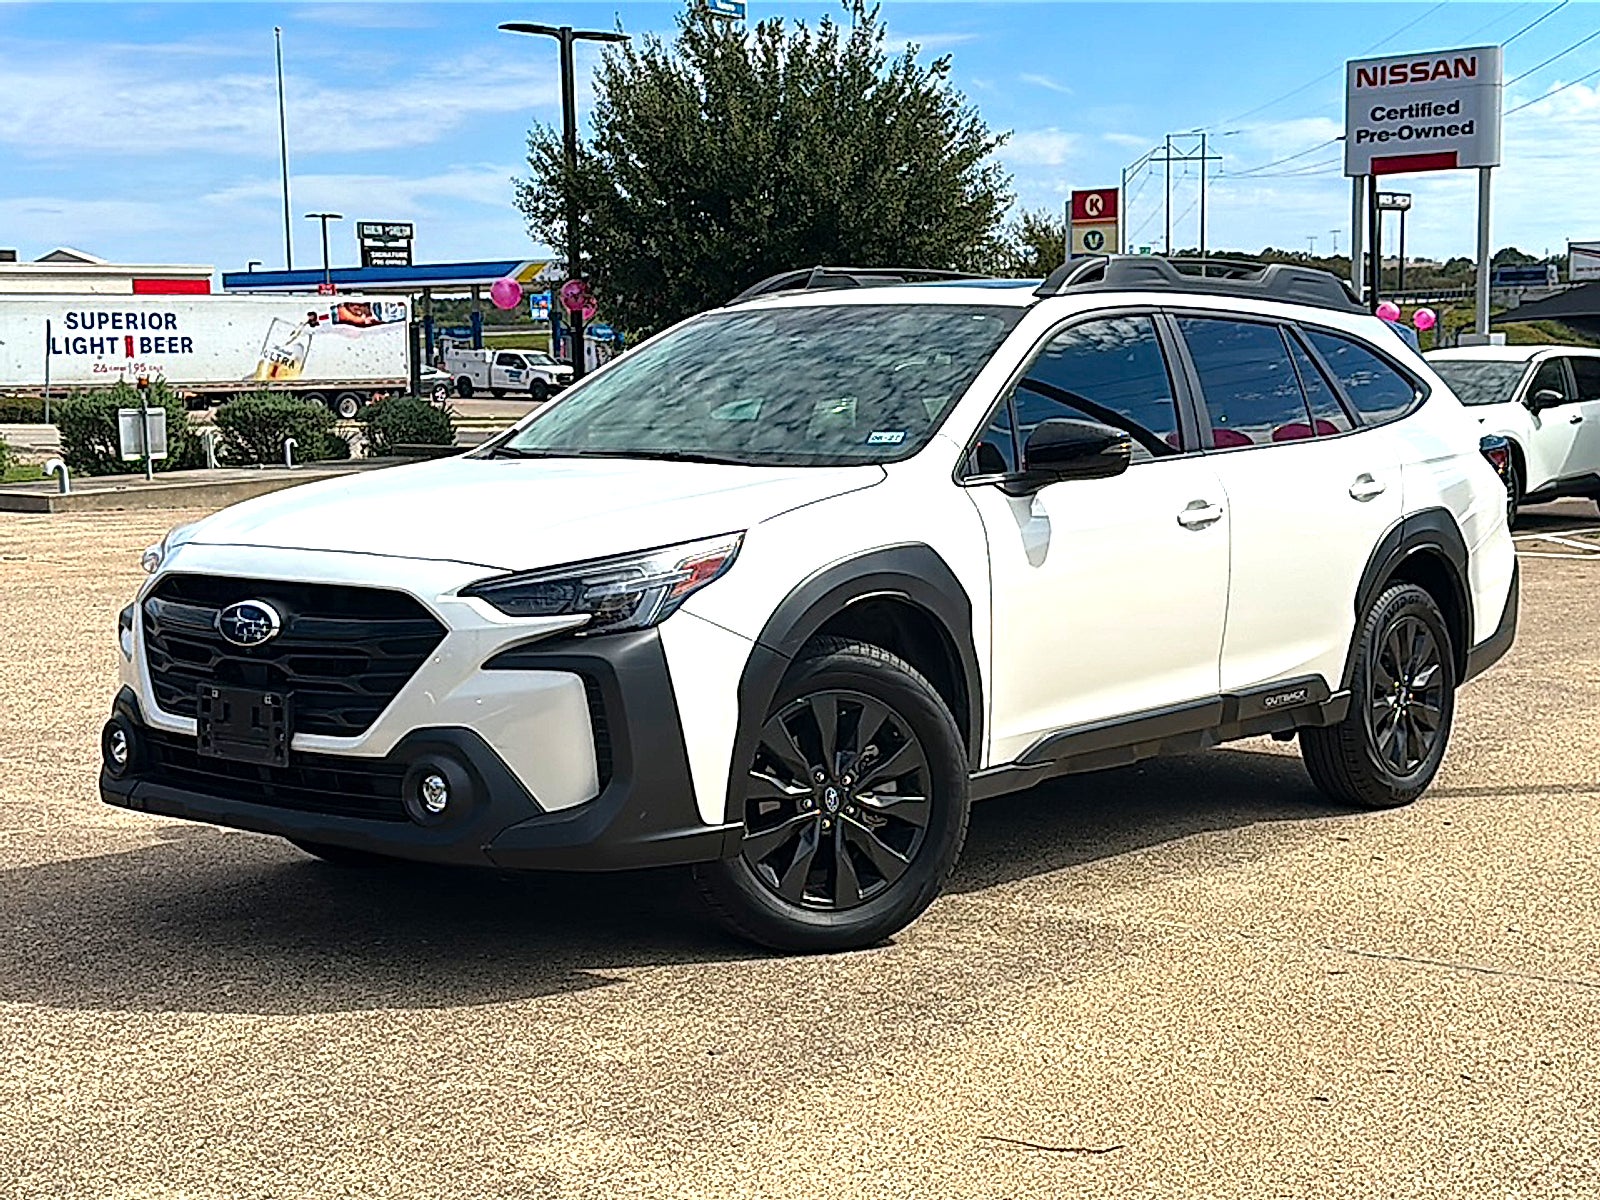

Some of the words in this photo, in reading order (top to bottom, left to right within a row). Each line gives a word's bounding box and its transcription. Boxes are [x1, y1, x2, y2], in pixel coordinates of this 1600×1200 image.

[1356, 56, 1476, 88] NISSAN
[1370, 100, 1460, 122] Certified
[1356, 120, 1474, 144] Pre-Owned
[66, 311, 177, 330] SUPERIOR
[51, 336, 119, 355] LIGHT
[139, 336, 194, 355] BEER
[1264, 689, 1306, 707] OUTBACK
